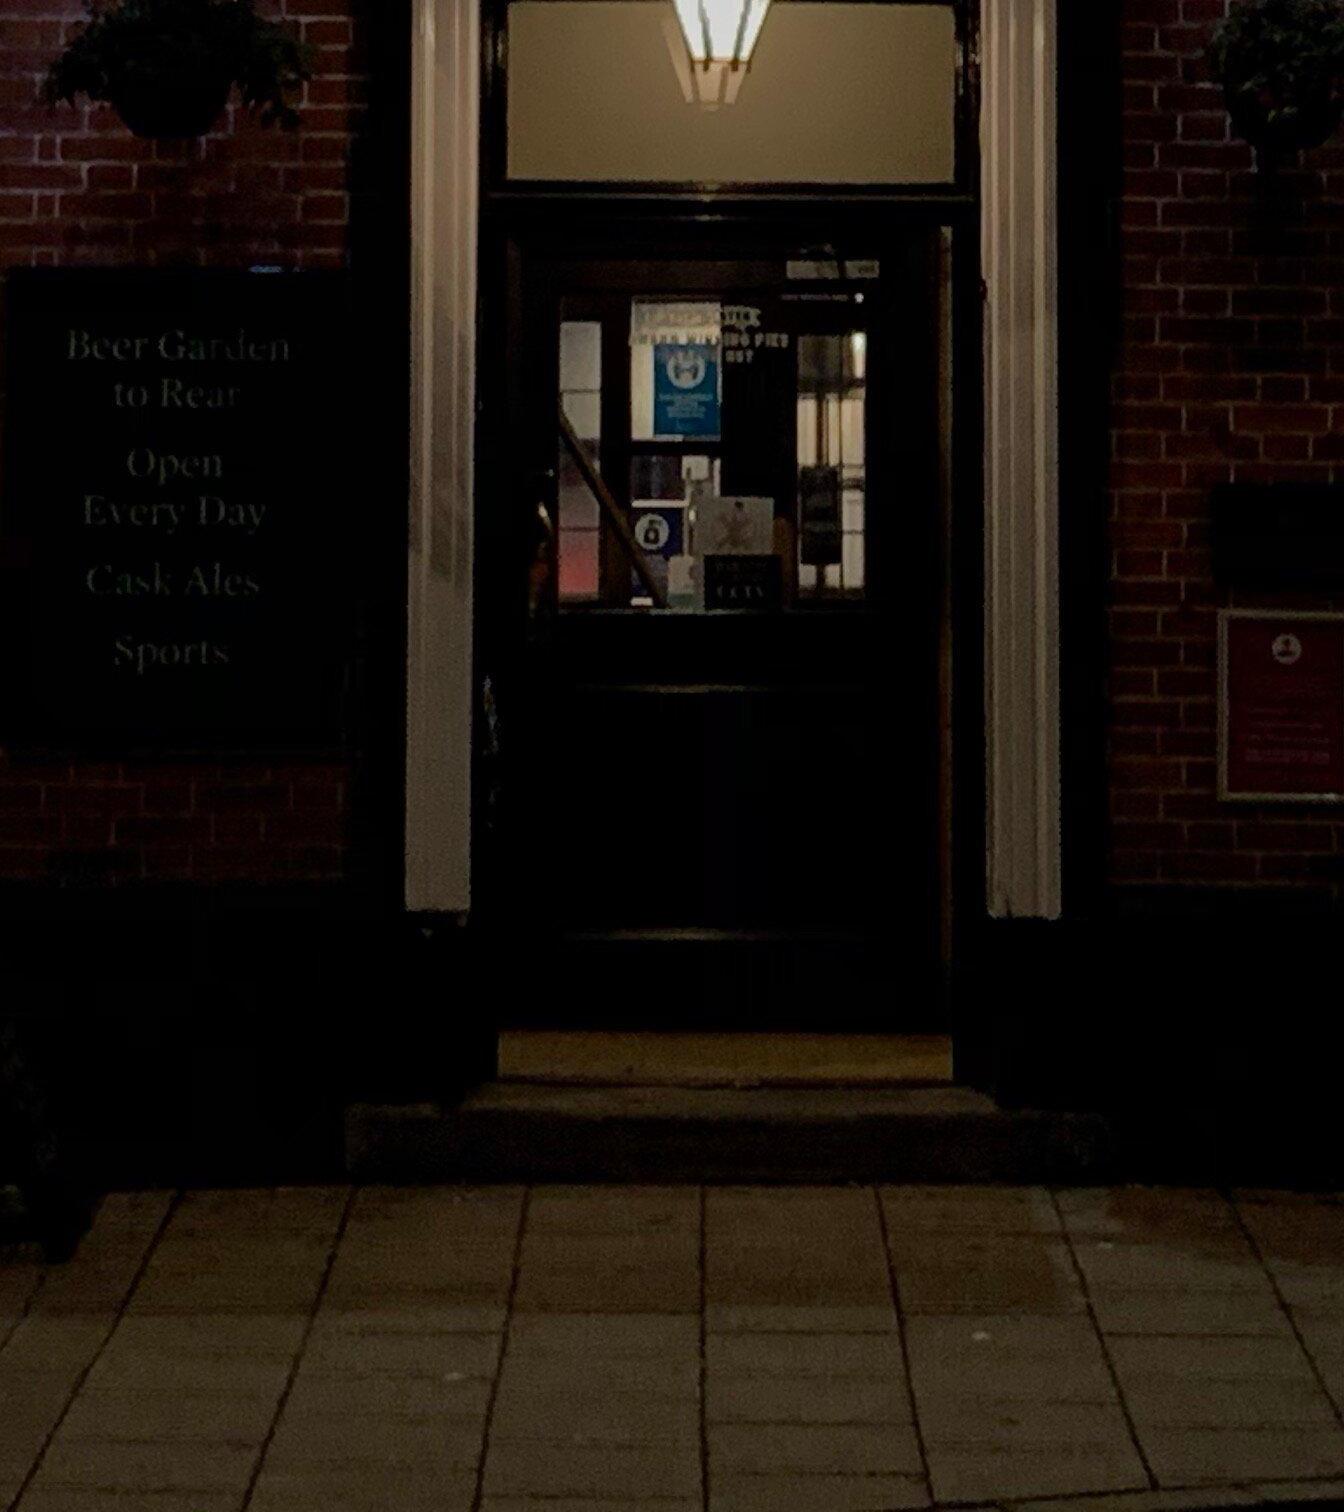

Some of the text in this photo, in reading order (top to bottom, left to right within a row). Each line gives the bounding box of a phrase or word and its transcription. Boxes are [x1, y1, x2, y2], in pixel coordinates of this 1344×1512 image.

[66, 327, 290, 361] Beer Garden
[113, 376, 242, 409] to Rear
[125, 447, 224, 486] Open
[82, 494, 267, 534] Every Day
[85, 561, 261, 598] Cask Ales
[112, 634, 232, 677] Sports
